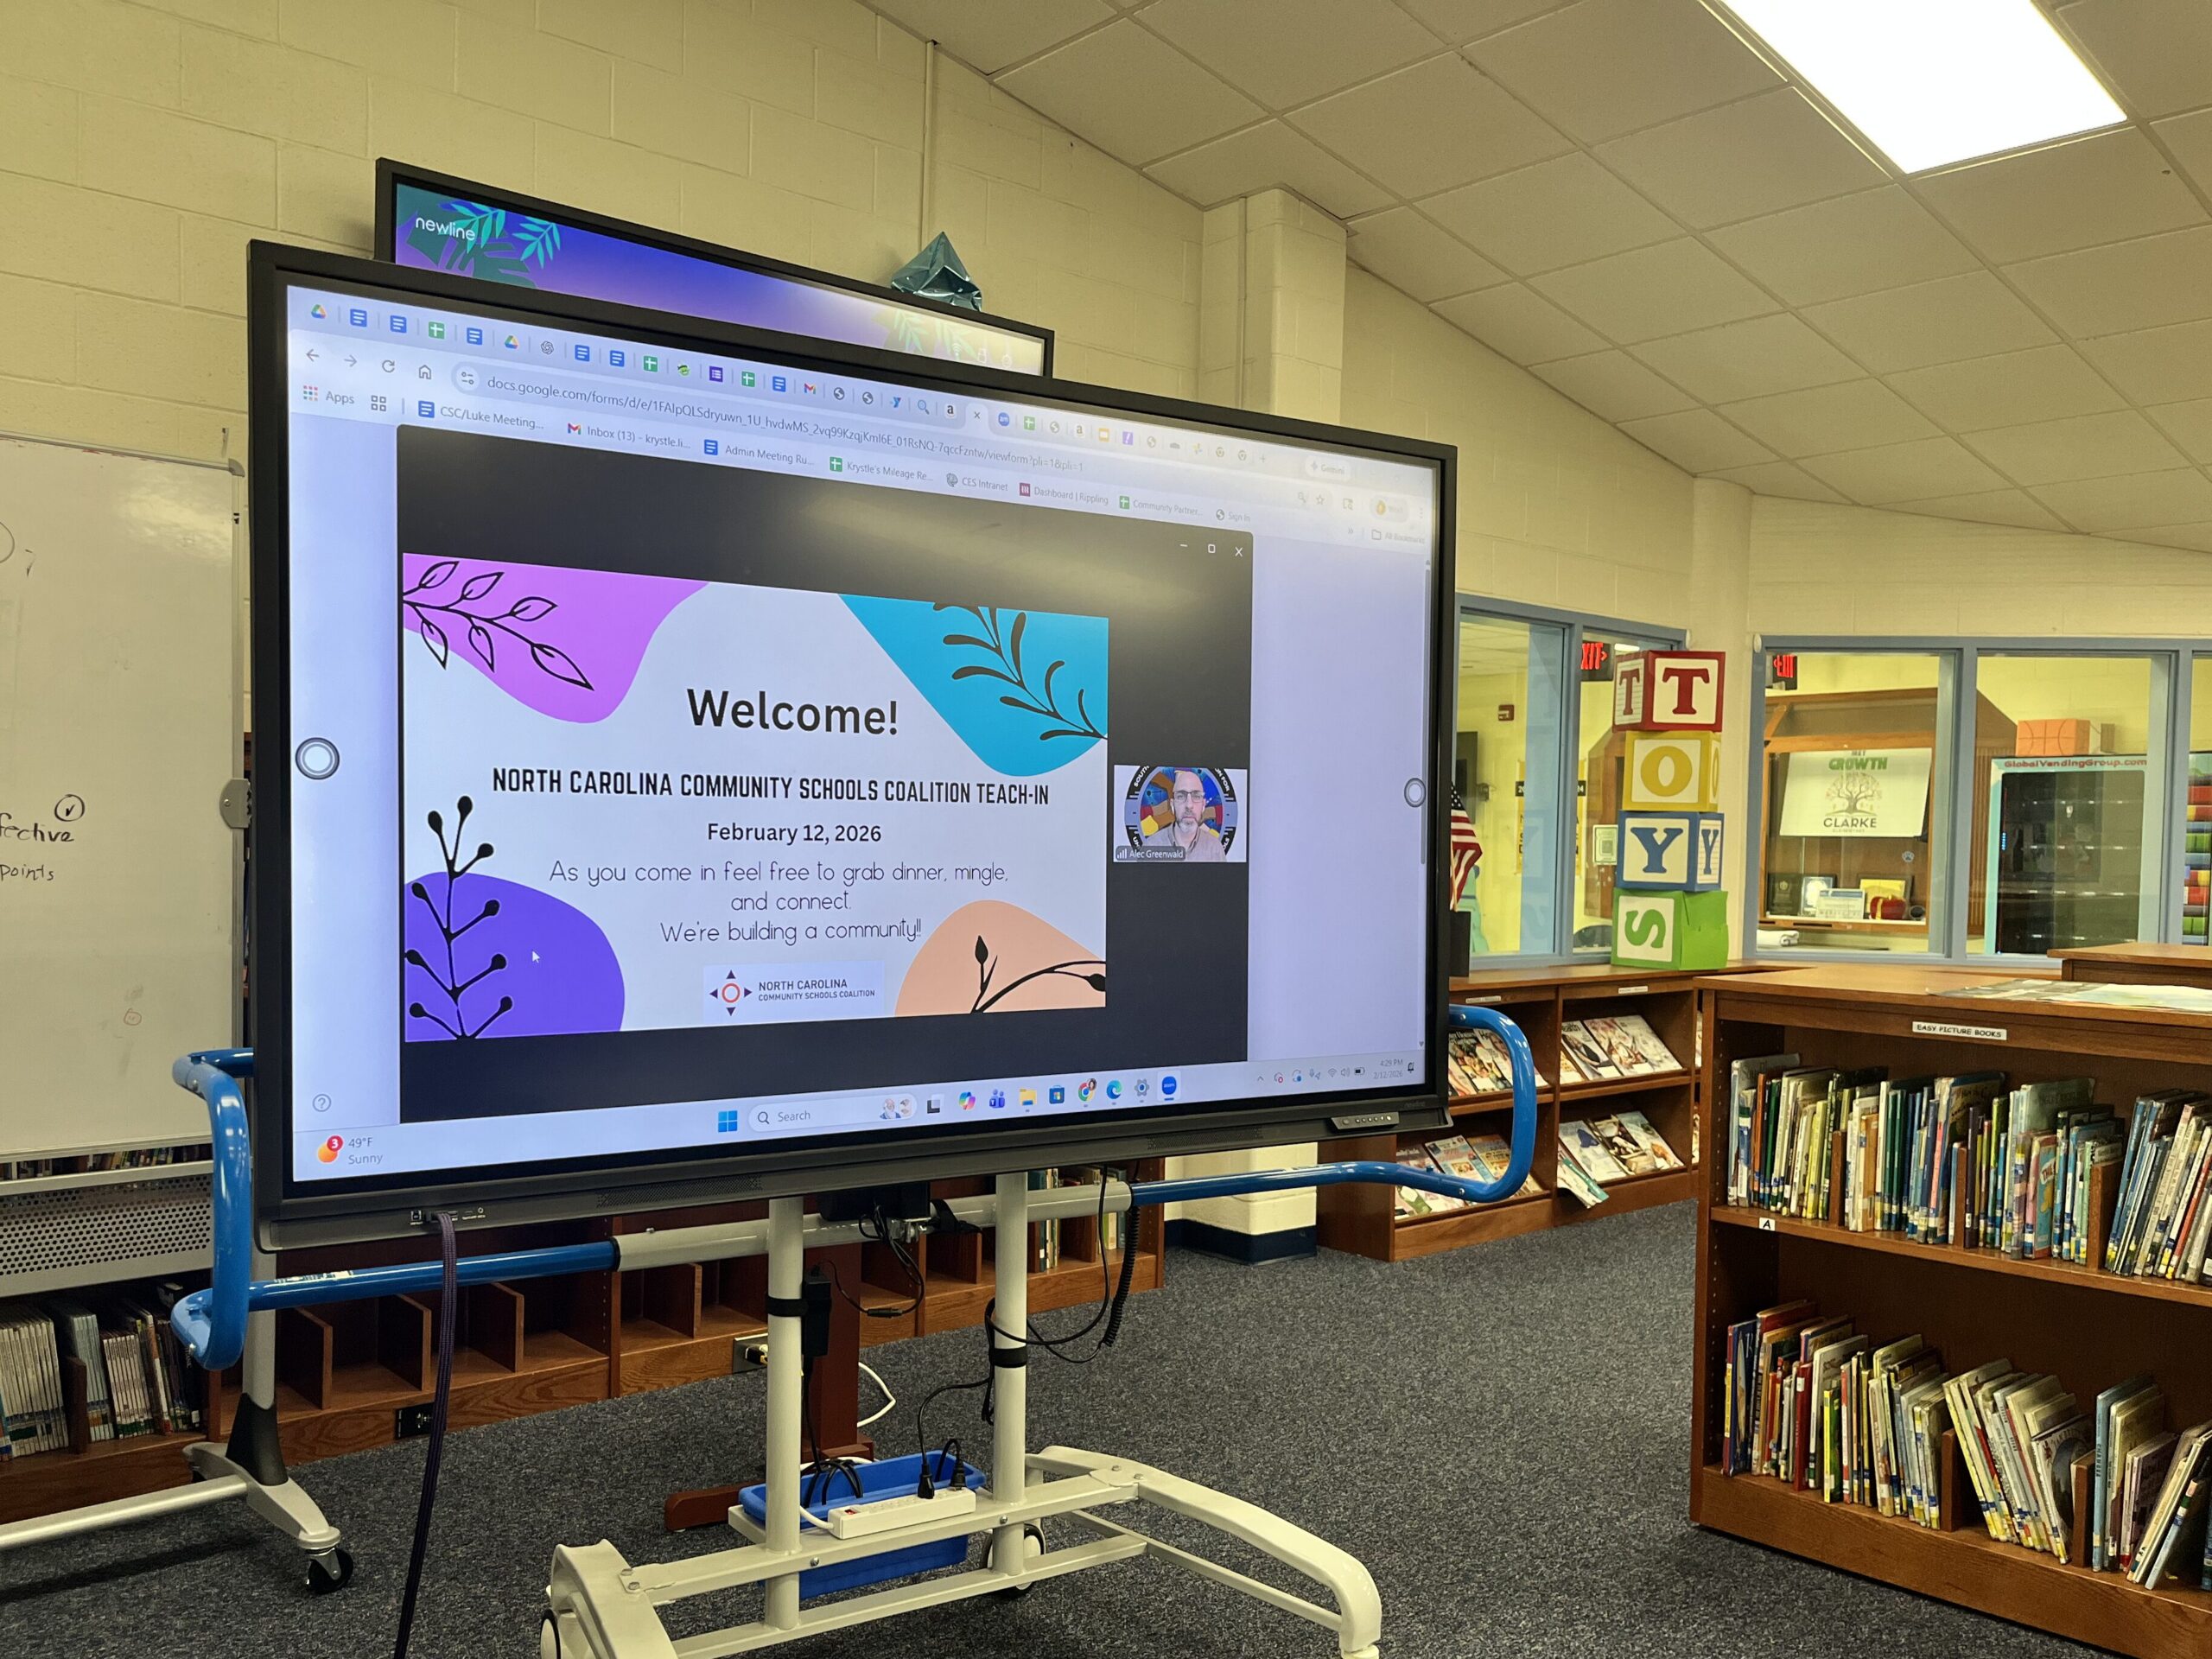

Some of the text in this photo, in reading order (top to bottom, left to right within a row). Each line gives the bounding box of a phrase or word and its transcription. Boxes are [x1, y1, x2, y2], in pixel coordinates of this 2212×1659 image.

[415, 217, 475, 240] newline
[326, 391, 355, 405] Apps
[440, 406, 544, 431] CSC/Luke Meeting...
[588, 425, 614, 439] Inbox
[617, 429, 636, 442] (13)
[726, 445, 815, 465] Admin Meeting Ru...
[848, 461, 880, 475] Krystle's
[883, 467, 914, 480] Mileage
[962, 477, 1008, 492] CES Intranet
[1034, 486, 1074, 500] Dashboard
[1079, 494, 1109, 506] Rippling
[1133, 499, 1172, 514] Community
[1580, 642, 1604, 670] XIT
[1619, 668, 1640, 715] T
[1662, 667, 1710, 715] T
[688, 688, 898, 735] Welcome!
[1640, 746, 1693, 797] O
[1828, 757, 1888, 771] GROWTH
[2005, 759, 2148, 768] GlobalVendingGroup.com
[493, 767, 1049, 805] NORTH CAROLINA COMMUNITY SCHOOLS COALITION TEACH-IN
[1823, 817, 1878, 828] CLARKE
[707, 823, 882, 846] February 12, 2026
[1128, 849, 1184, 859] Alec Greenwald
[1630, 827, 1683, 874] Y
[0, 864, 54, 881] points
[550, 860, 1009, 889] As you come in feel free to grab dinner, mingle,
[730, 891, 852, 912] and connect.
[660, 918, 922, 946] We're building a community!!
[759, 978, 849, 992] NORTH CAROLINA
[758, 989, 875, 1001] COMMUNITY SCHOOLS COALITION
[1938, 1027, 1973, 1035] PICTURE
[1974, 1029, 2002, 1038] BOOKS
[1373, 1071, 1403, 1080] 2/12/2026
[777, 1109, 810, 1123] Search
[331, 1138, 339, 1149] 3
[348, 1136, 373, 1148] 49°F
[347, 1154, 383, 1166] Sunny
[1763, 1219, 1771, 1230] A
